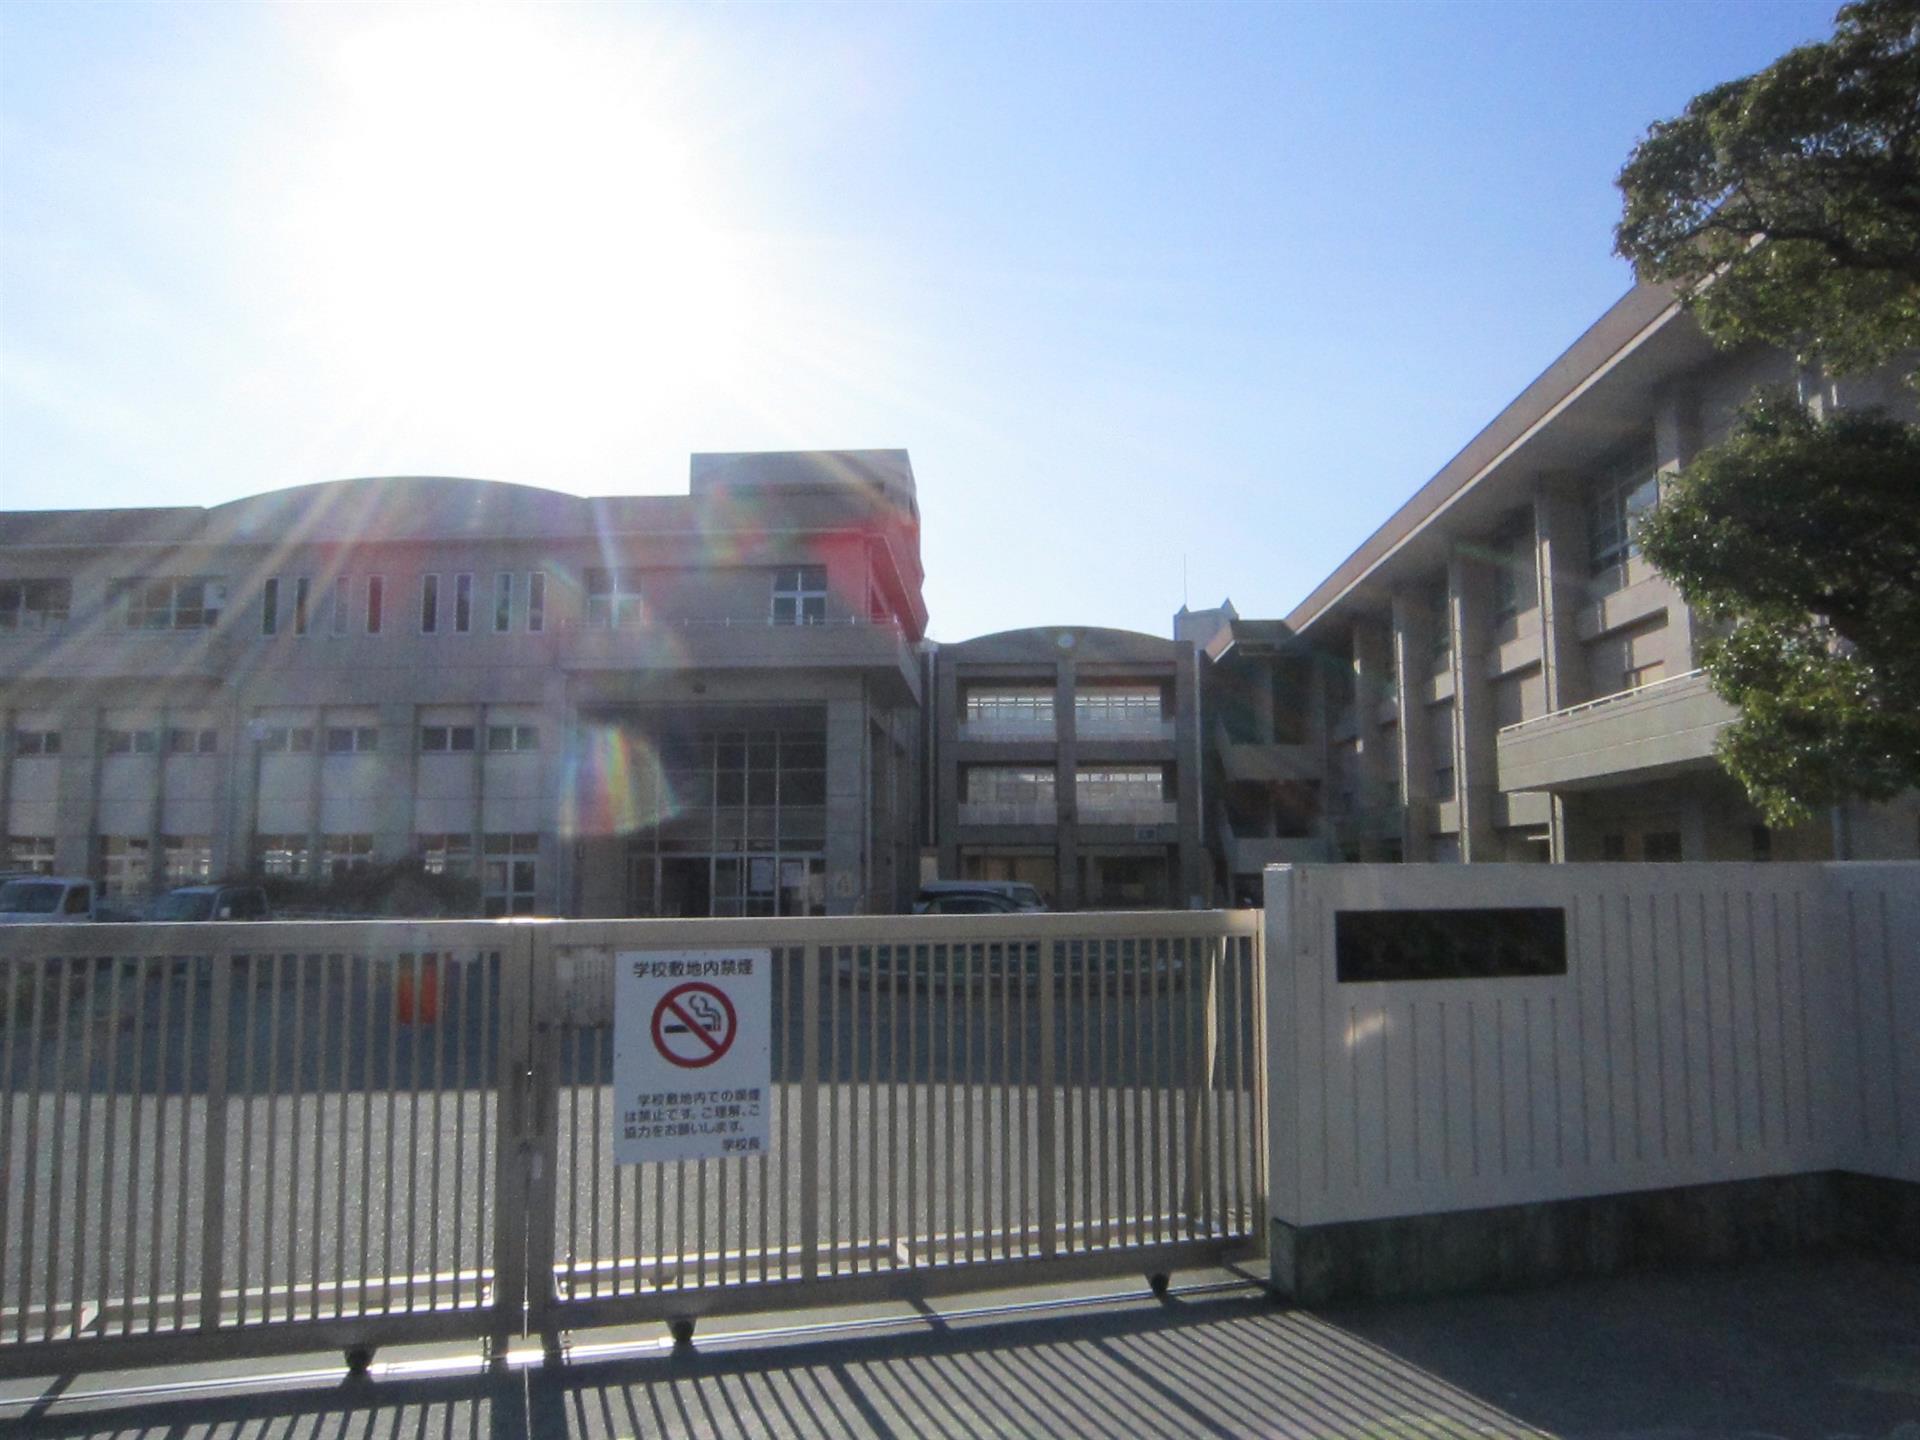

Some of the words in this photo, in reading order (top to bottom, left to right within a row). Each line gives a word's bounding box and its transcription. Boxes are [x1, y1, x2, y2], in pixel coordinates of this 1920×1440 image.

[633, 958, 753, 978] 学校敷地内禁煙
[722, 1137, 761, 1152] 学校長
